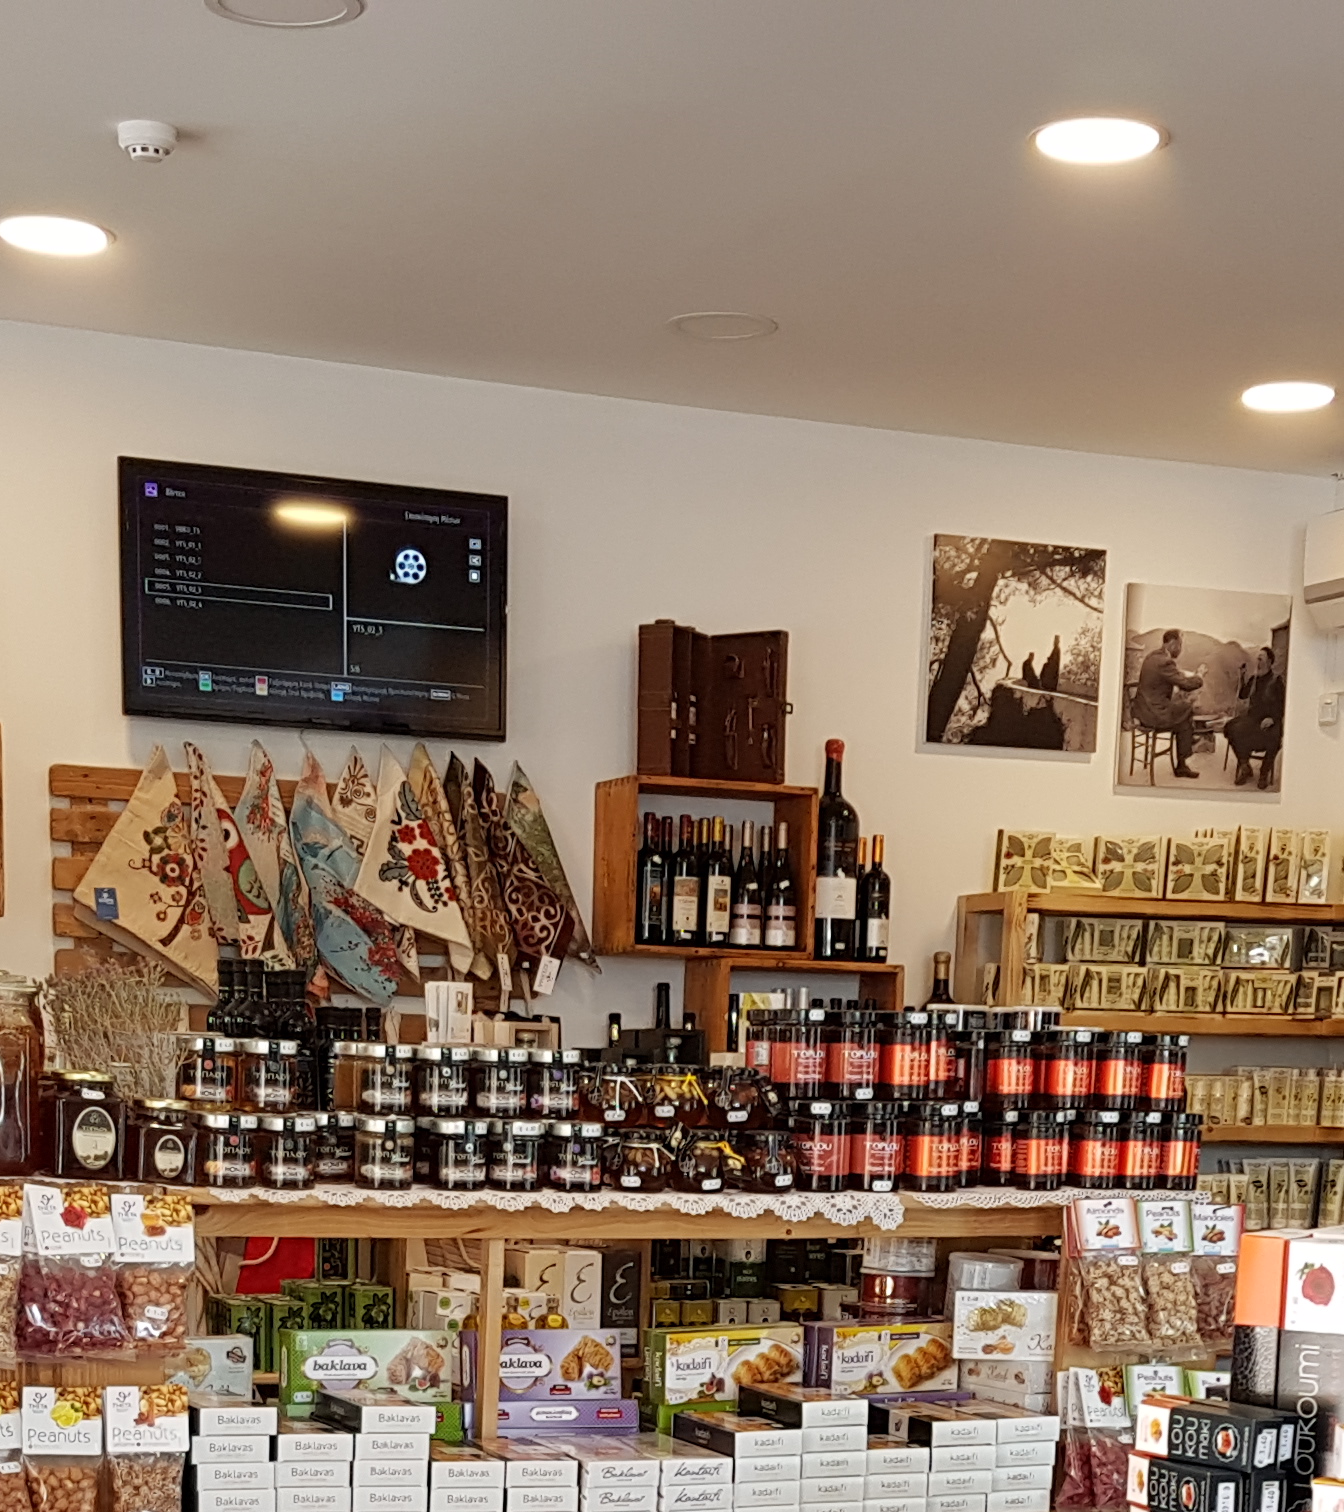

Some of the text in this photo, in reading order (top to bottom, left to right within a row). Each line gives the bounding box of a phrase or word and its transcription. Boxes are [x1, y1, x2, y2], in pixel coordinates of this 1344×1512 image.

[1086, 1207, 1125, 1216] Almonds
[1145, 1208, 1181, 1219] Peanuts
[1193, 1212, 1235, 1222] Mandoles
[41, 1228, 106, 1244] Peanuts
[117, 1237, 183, 1251] Peanuts
[840, 1350, 875, 1364] kadaifi
[312, 1358, 368, 1372] baklava
[500, 1358, 543, 1369] aklava
[675, 1357, 713, 1373] kadaifi
[1136, 1372, 1174, 1382] Peanuts
[216, 1414, 262, 1426] Baklavas
[377, 1412, 421, 1425] Baklavas
[27, 1427, 92, 1444] Peanuts
[112, 1426, 178, 1441] Peanuts
[1170, 1415, 1185, 1455] LOU
[1185, 1417, 1199, 1457] KOU
[208, 1442, 254, 1453] Baklavas
[882, 1454, 912, 1466] kadaifi
[214, 1469, 259, 1481] Baklavas
[446, 1493, 488, 1505] Baklavas
[522, 1493, 563, 1505] Baklavas
[939, 1498, 970, 1510] kadaifi
